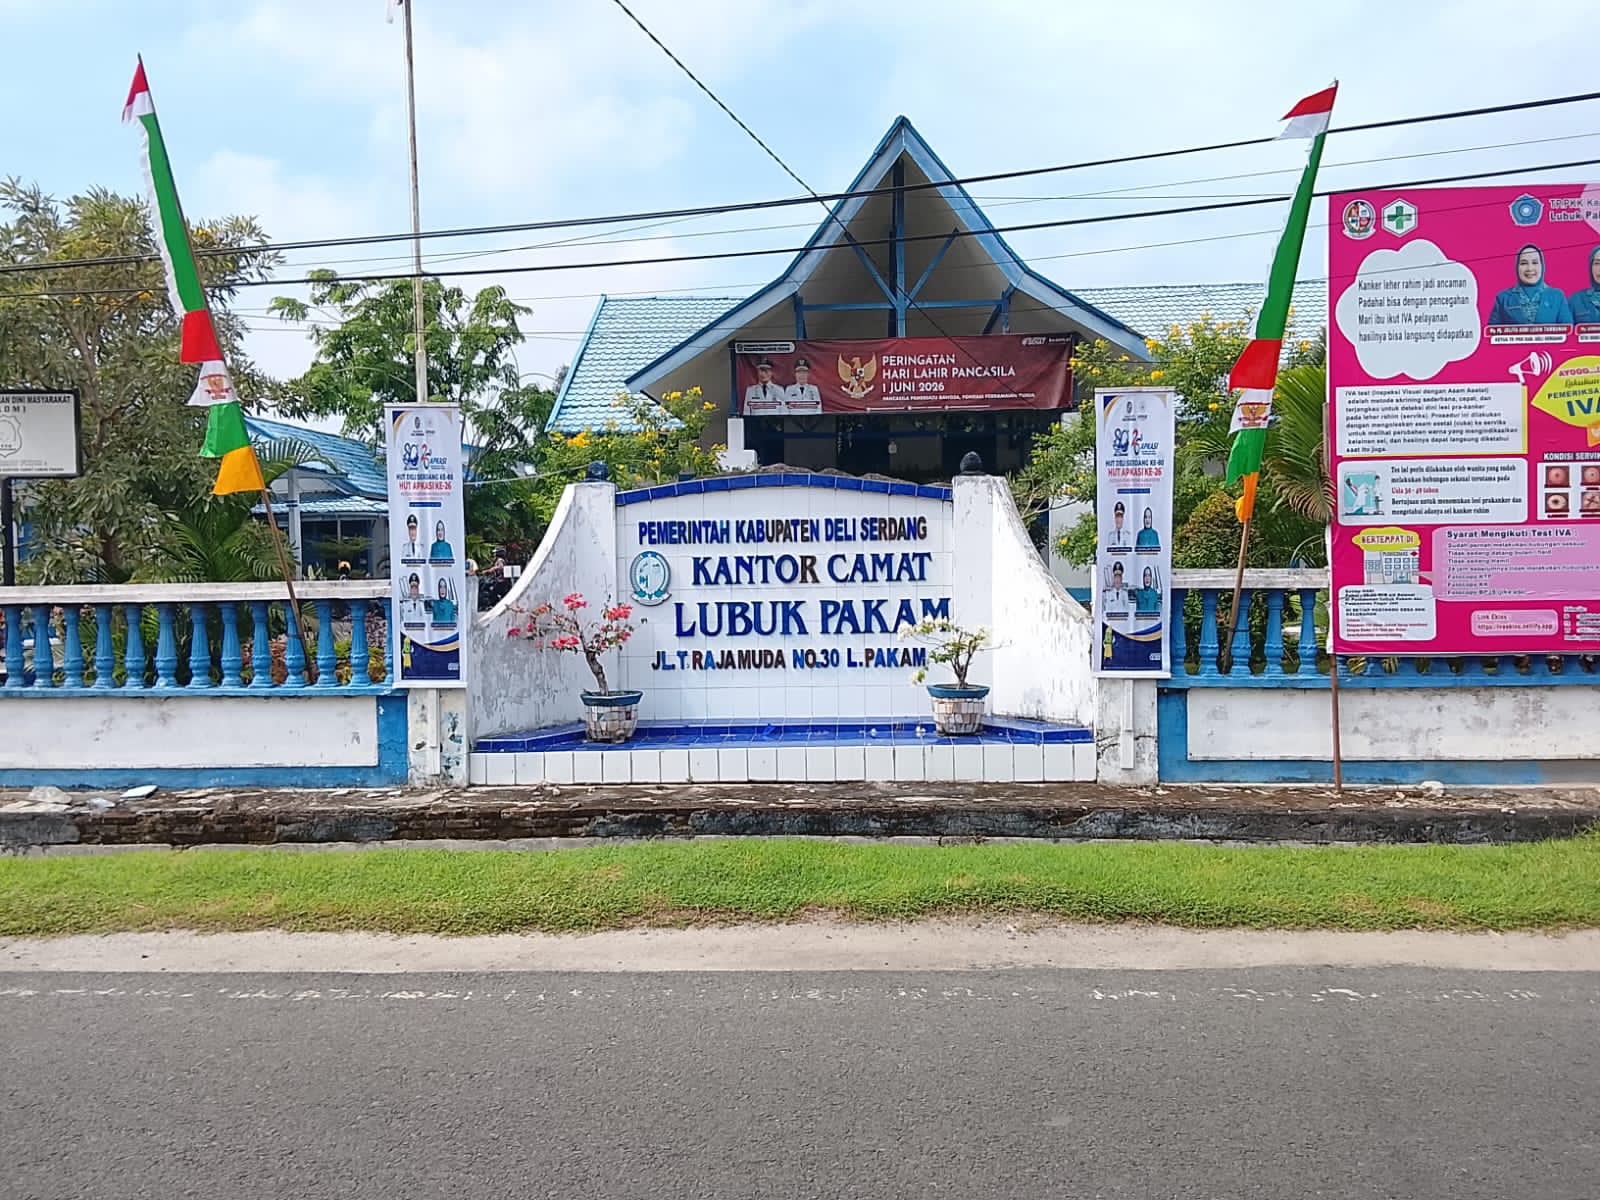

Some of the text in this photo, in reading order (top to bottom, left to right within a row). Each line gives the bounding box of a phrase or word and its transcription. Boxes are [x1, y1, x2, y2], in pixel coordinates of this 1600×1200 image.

[1586, 211, 1600, 219] Pa
[1359, 279, 1466, 291] Kanker leher rahim jadi ancaman
[1359, 296, 1469, 308] Padahal bisa dengan pencegahan
[1359, 313, 1448, 325] Mari ibu ikut IVA pelayanan
[1359, 329, 1473, 343] hasilnya bisa langsung didapatkan
[882, 354, 956, 367] PERINGATAN
[883, 366, 1016, 380] HARI LAHIR PANCASILA
[889, 382, 915, 393] JUNI
[919, 382, 945, 392] 2026
[1567, 397, 1600, 416] IV
[399, 482, 411, 490] HUT
[639, 516, 927, 545] PEMERINTAH KABUPATEN DELI SERDANG
[1447, 531, 1478, 539] Syarat
[1481, 529, 1528, 539] Mengikuti
[1532, 529, 1552, 537] Test
[1362, 535, 1414, 544] BERTEMPAT DI
[692, 551, 932, 586] KANTOR CAMAT
[675, 597, 952, 637] LUBUK PAKAM
[793, 648, 840, 669] NO.30
[847, 647, 926, 668] L.PAKAM
